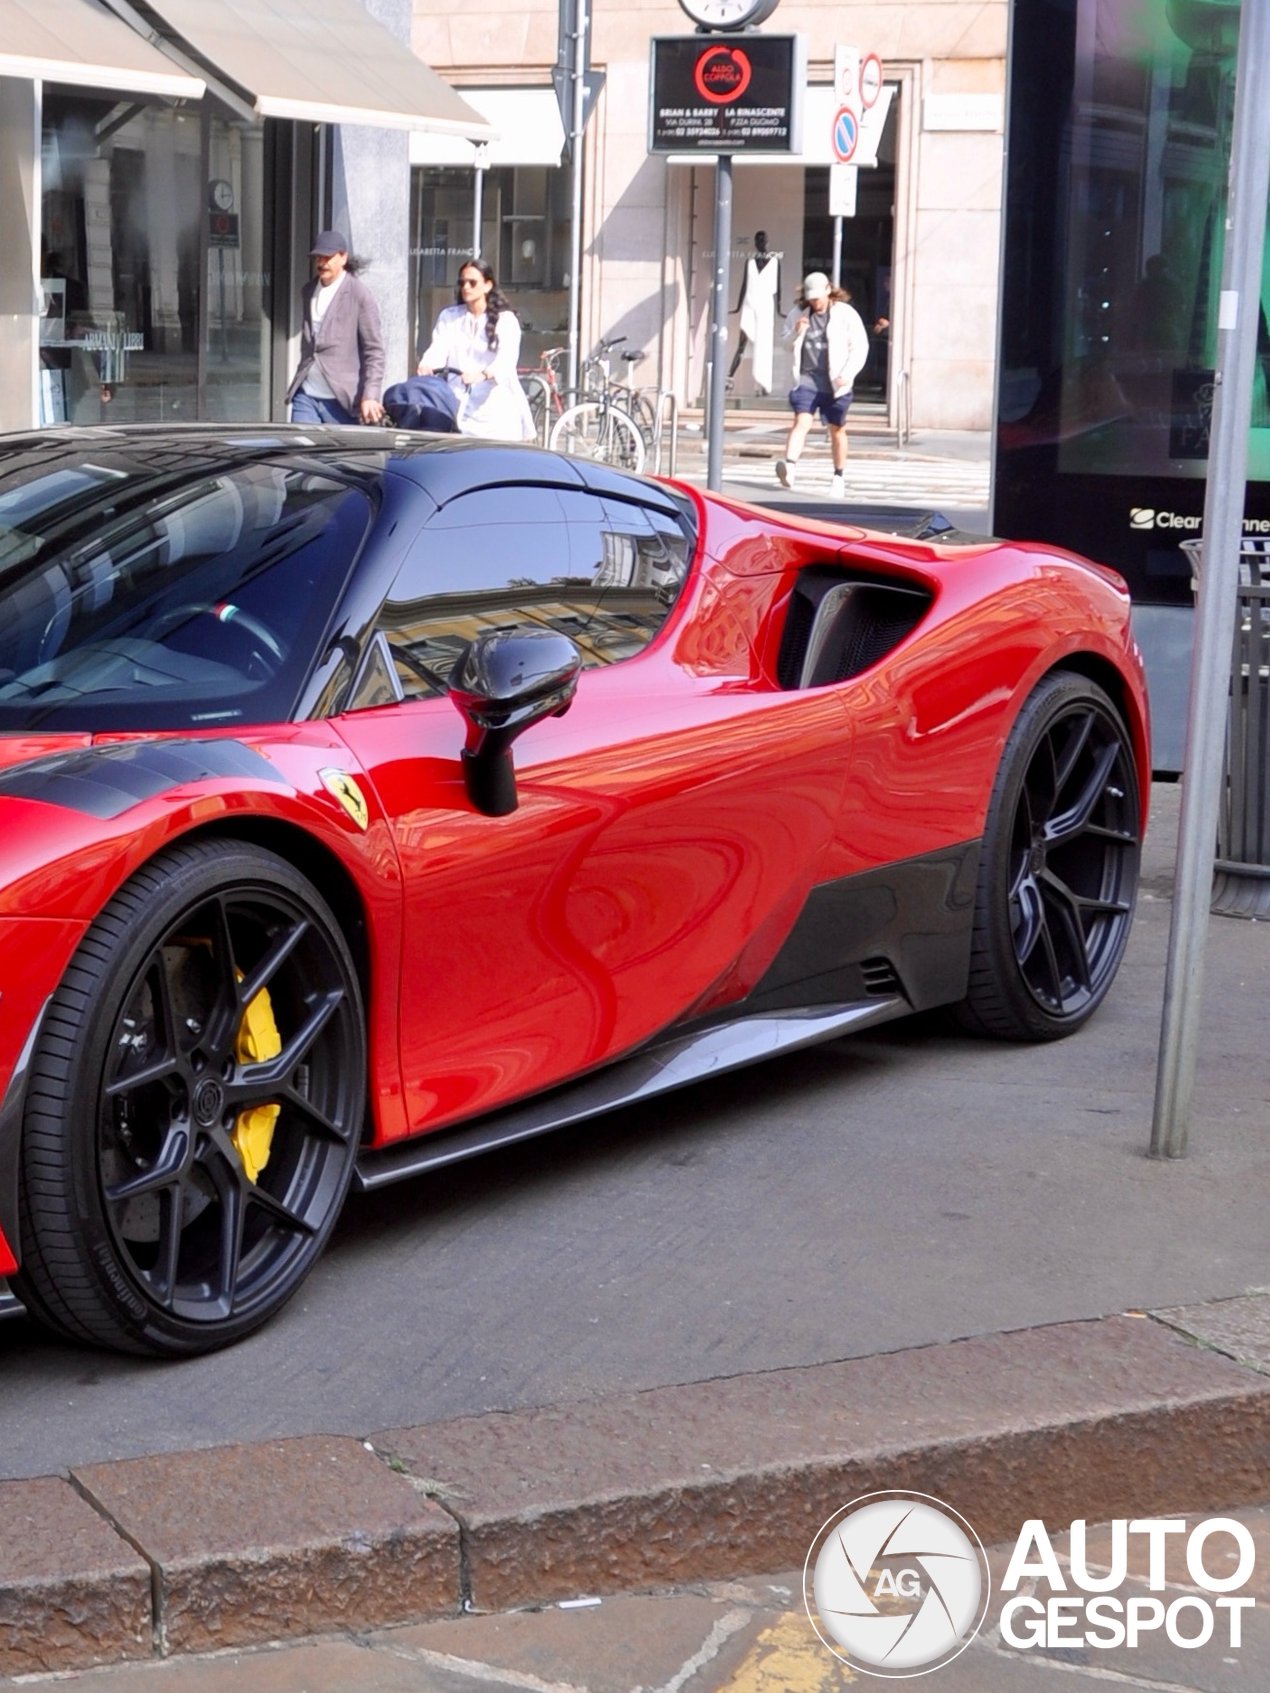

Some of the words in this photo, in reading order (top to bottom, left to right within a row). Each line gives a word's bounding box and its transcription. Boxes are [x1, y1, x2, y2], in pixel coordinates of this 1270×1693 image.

[659, 108, 684, 117] BRIAN
[693, 108, 719, 117] BARRY
[724, 108, 736, 117] LA
[737, 107, 786, 117] RINASCENTE
[1156, 511, 1202, 529] Clear
